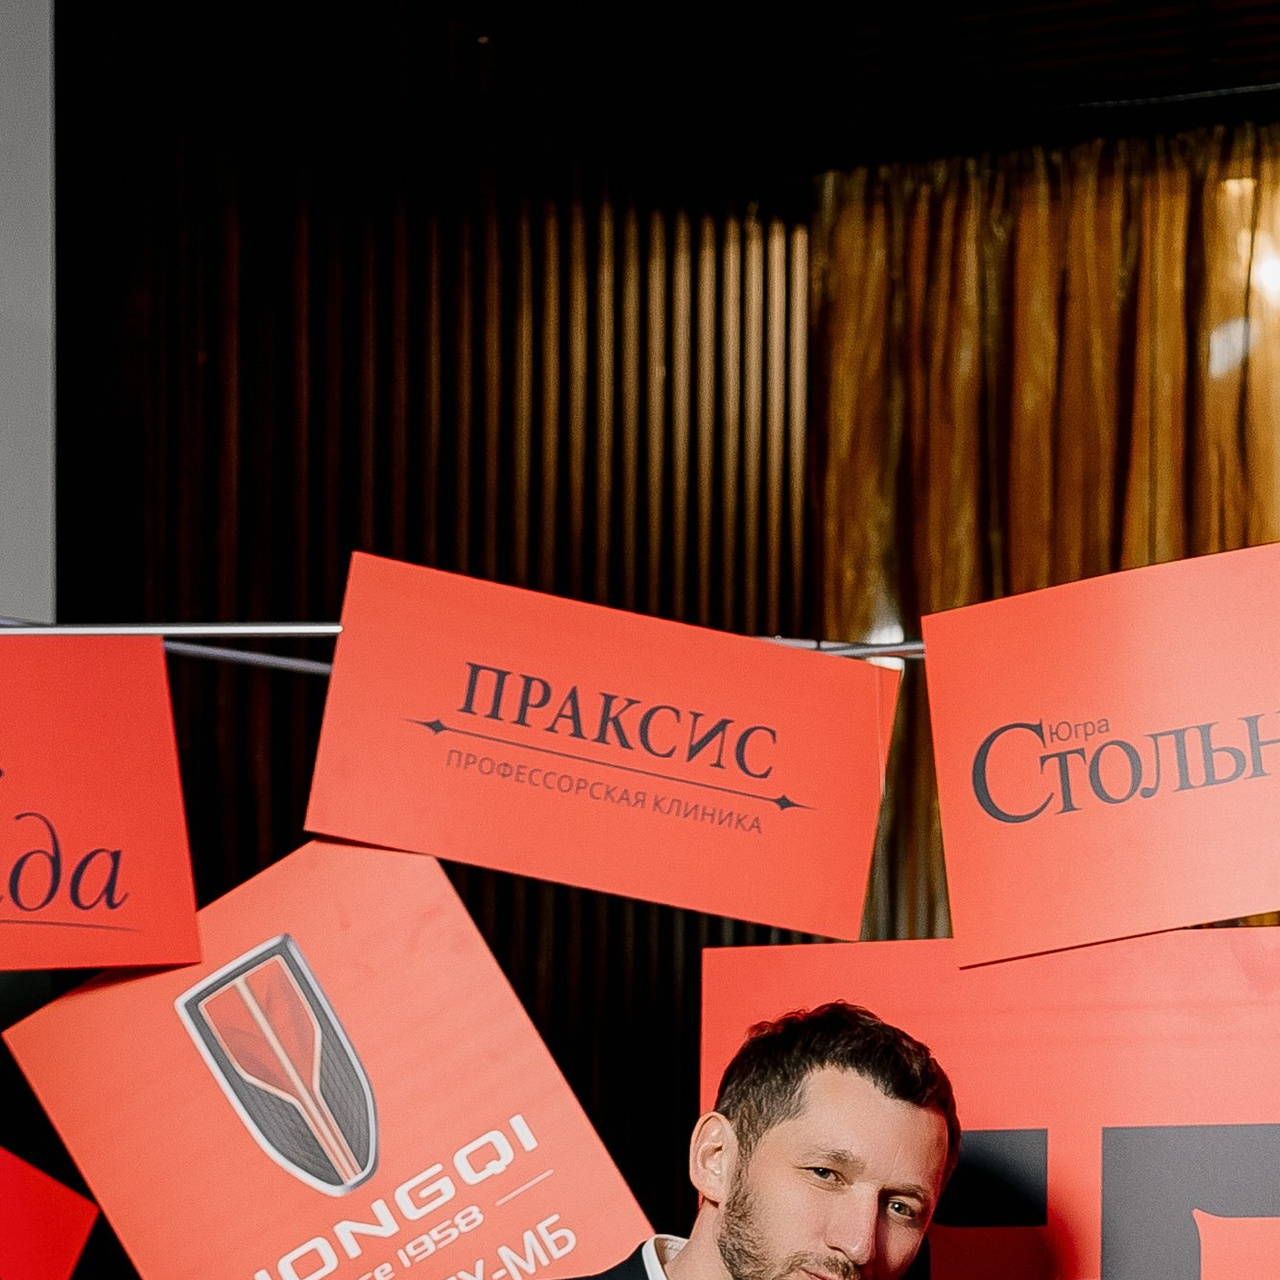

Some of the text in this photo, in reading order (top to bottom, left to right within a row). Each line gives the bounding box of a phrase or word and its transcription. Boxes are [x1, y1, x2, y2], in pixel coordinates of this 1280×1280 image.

[456, 662, 778, 779] ПРАКСИС
[1048, 717, 1110, 743] Югра
[446, 748, 764, 834] ПРОФЕССОРСКАЯ КЛИНИКА
[396, 1204, 486, 1269] 1958
